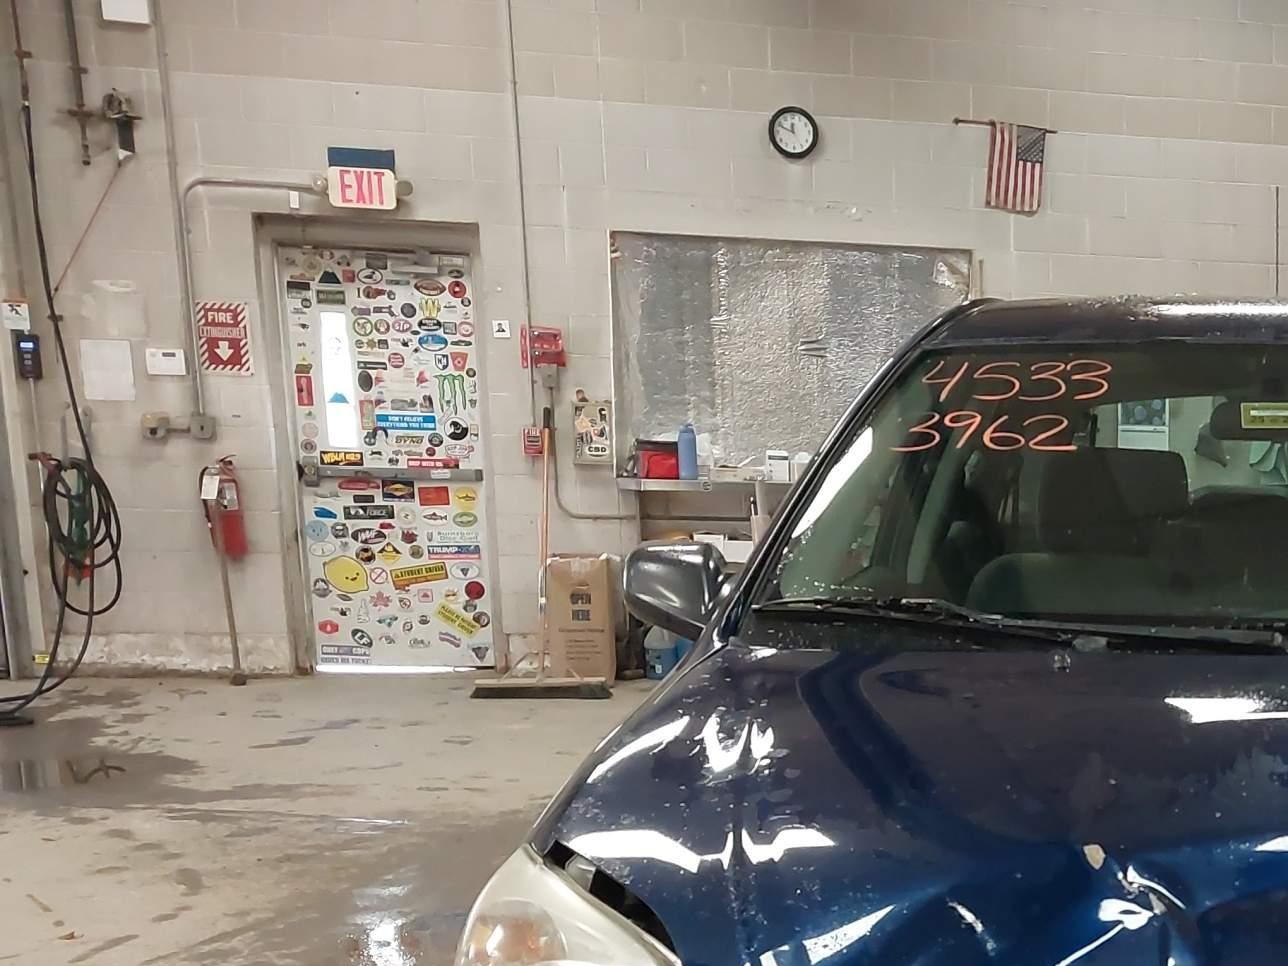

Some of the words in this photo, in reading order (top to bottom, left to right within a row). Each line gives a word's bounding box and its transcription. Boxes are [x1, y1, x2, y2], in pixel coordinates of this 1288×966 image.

[338, 169, 385, 206] EXIT
[207, 311, 234, 324] FIRE
[394, 320, 410, 329] STP
[199, 325, 247, 339] EXTINGUISHER
[922, 359, 1112, 402] 4533
[889, 410, 1078, 452] 3962
[395, 435, 425, 445] DYNO
[428, 545, 458, 554] TRUMP
[569, 592, 591, 605] OPEN
[571, 609, 591, 621] HERE
